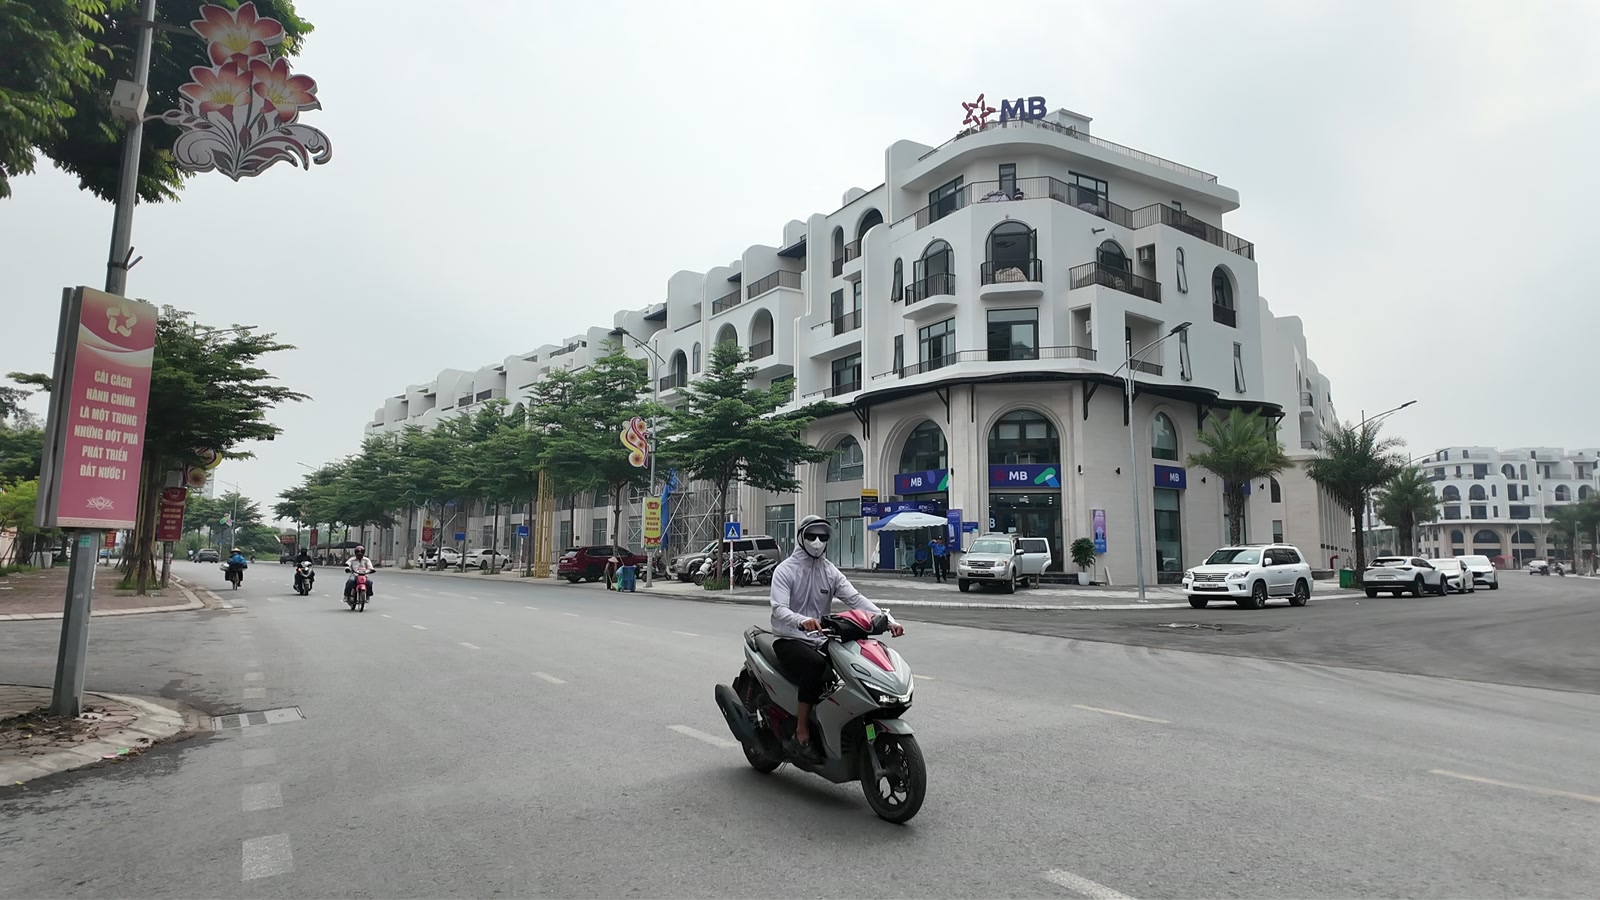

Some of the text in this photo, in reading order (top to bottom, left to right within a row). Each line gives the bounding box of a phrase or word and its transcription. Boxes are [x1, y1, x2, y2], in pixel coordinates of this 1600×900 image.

[1000, 96, 1047, 123] MB
[111, 374, 132, 389] CÁCH
[86, 387, 136, 408] HÀNH CHÍNH
[80, 405, 138, 426] LÀ MỘT TRONG
[74, 424, 103, 440] NHỮNG
[122, 432, 138, 445] PHÁ
[82, 444, 104, 459] PHÁT
[910, 477, 922, 487] MB
[1009, 471, 1028, 481] MB
[1169, 472, 1180, 482] MB
